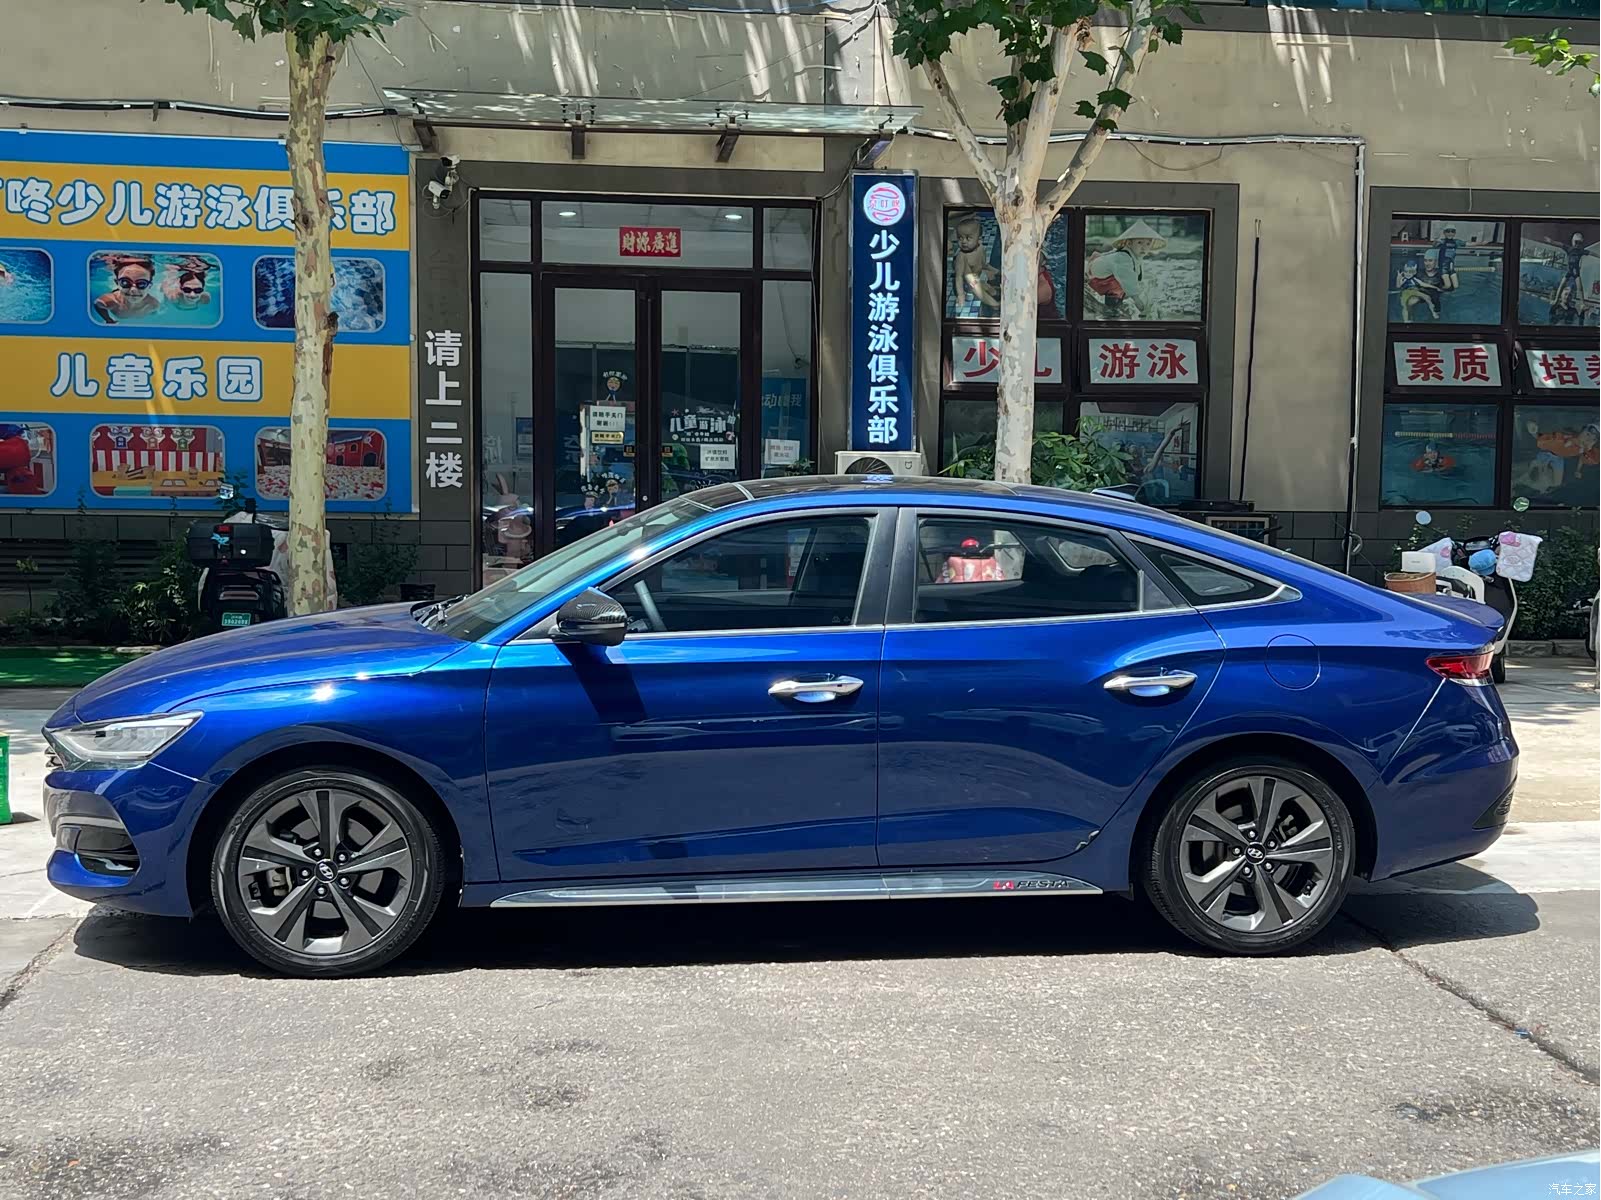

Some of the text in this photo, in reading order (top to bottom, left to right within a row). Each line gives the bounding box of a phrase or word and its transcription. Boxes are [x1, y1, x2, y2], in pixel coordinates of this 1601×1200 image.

[0, 177, 397, 235] 咚少儿游泳俱部
[867, 229, 900, 444] 少儿游泳俱乐部
[1099, 342, 1189, 380] 游泳
[50, 352, 262, 402] 儿童乐园
[1405, 346, 1491, 382] 素质
[424, 329, 463, 489] 请上二楼
[1017, 880, 1072, 889] FESTA
